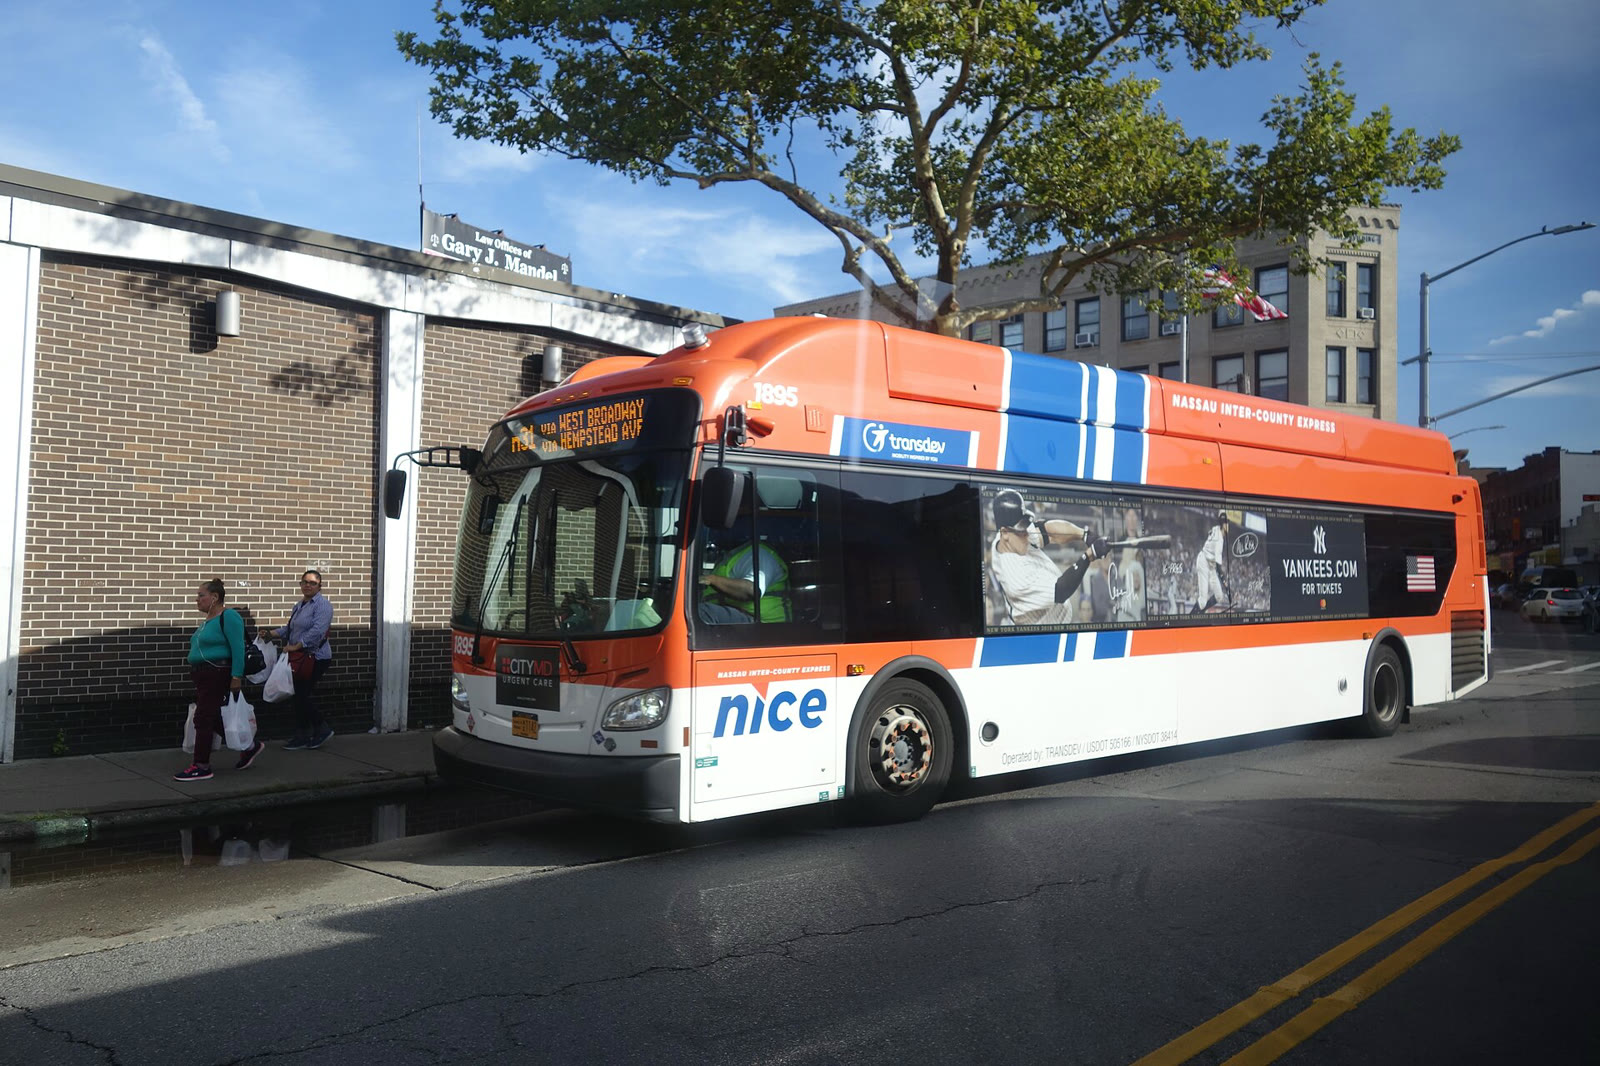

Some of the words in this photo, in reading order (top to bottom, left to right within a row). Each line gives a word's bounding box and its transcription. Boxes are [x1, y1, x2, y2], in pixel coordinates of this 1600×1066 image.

[442, 233, 482, 263] Gary
[485, 249, 499, 266] J.
[504, 253, 558, 281] Mandel
[475, 232, 493, 246] Law
[494, 238, 522, 256] Offices
[523, 249, 533, 260] of
[754, 382, 798, 408] 1895
[541, 422, 556, 435] VIA
[559, 410, 584, 432] WEST
[588, 398, 644, 427] BROADWAY
[1172, 394, 1217, 414] NASSAU
[1220, 402, 1295, 426] INTER-COUNTY
[1297, 416, 1336, 434] EXPRESS
[542, 440, 558, 453] VIA
[560, 423, 618, 450] HEMPSTEAD
[889, 434, 945, 454] transdev
[1282, 558, 1358, 578] YANKEES.COM
[1302, 583, 1315, 595] FOR
[1317, 582, 1342, 594] TICKETS
[454, 635, 475, 656] 1895
[502, 675, 530, 686] URGENT
[533, 678, 553, 688] CARE
[717, 671, 747, 679] NASSAU
[748, 667, 800, 676] INTER-COUNTY
[801, 665, 831, 673] EXPRESS
[713, 688, 827, 738] nice
[1002, 749, 1032, 766] Operated
[1034, 747, 1043, 762] by:
[1045, 743, 1081, 759] TRANSDEV
[1086, 738, 1108, 753] USDOT
[1109, 735, 1131, 750] 505166
[1135, 732, 1159, 746] NYSDOT
